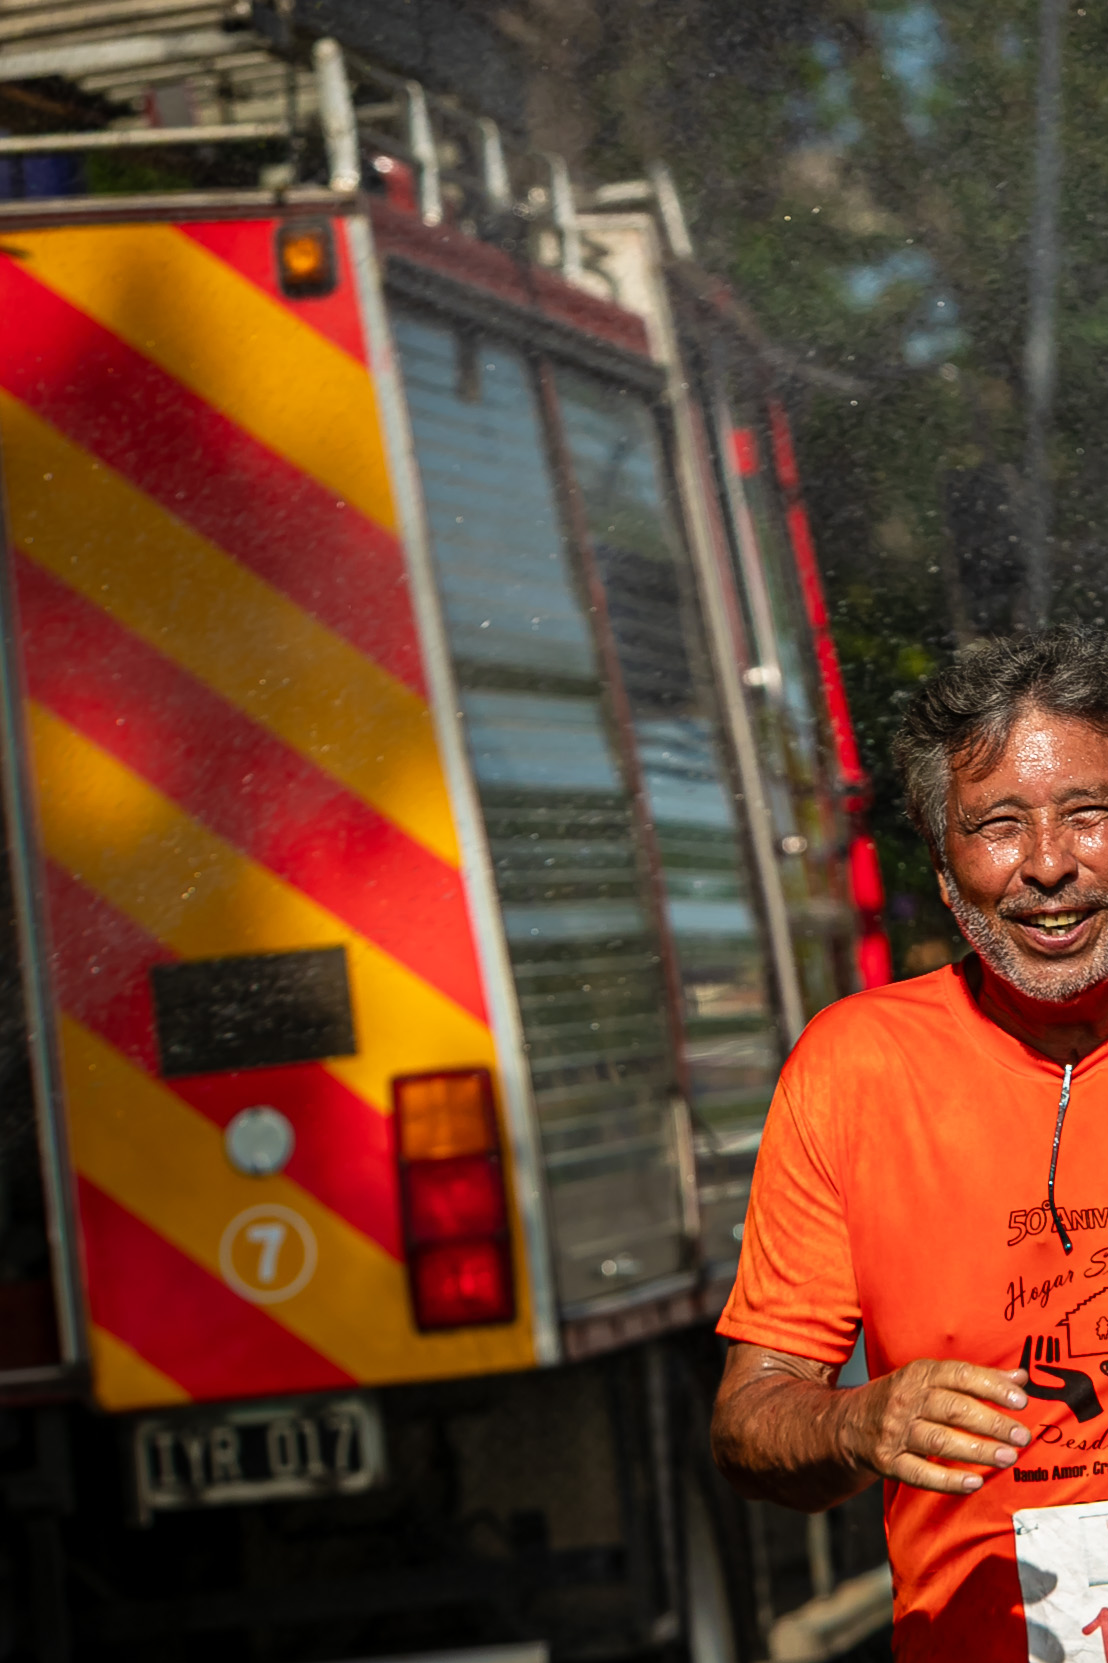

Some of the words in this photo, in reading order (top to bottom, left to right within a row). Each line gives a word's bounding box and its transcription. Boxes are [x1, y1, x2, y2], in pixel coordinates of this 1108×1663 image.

[246, 1222, 286, 1283] 7
[1004, 1270, 1075, 1321] Hogar
[266, 1416, 352, 1480] 017
[1013, 1466, 1049, 1483] Dando
